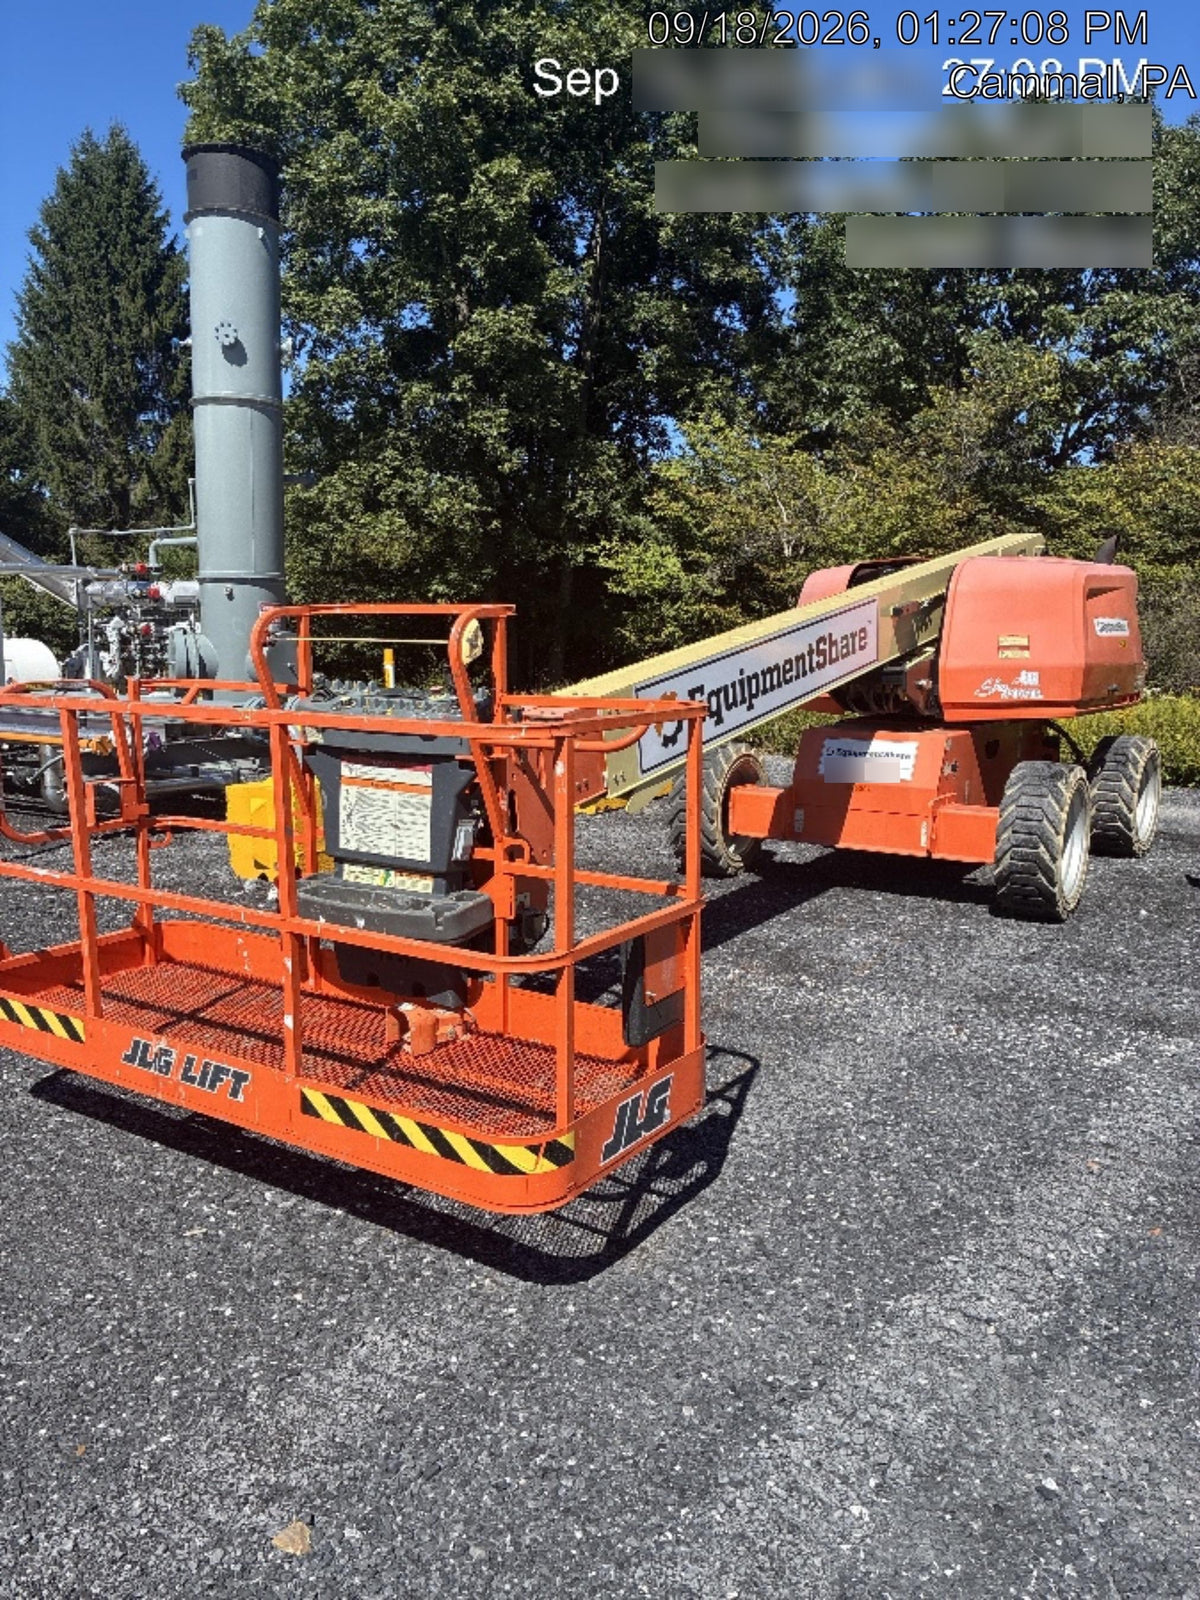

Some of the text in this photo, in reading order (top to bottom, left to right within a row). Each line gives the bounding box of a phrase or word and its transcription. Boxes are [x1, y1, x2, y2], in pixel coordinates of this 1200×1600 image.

[688, 626, 868, 727] EquipmentShare
[121, 1037, 251, 1102] JLG LIFT
[599, 1072, 675, 1166] JLG
